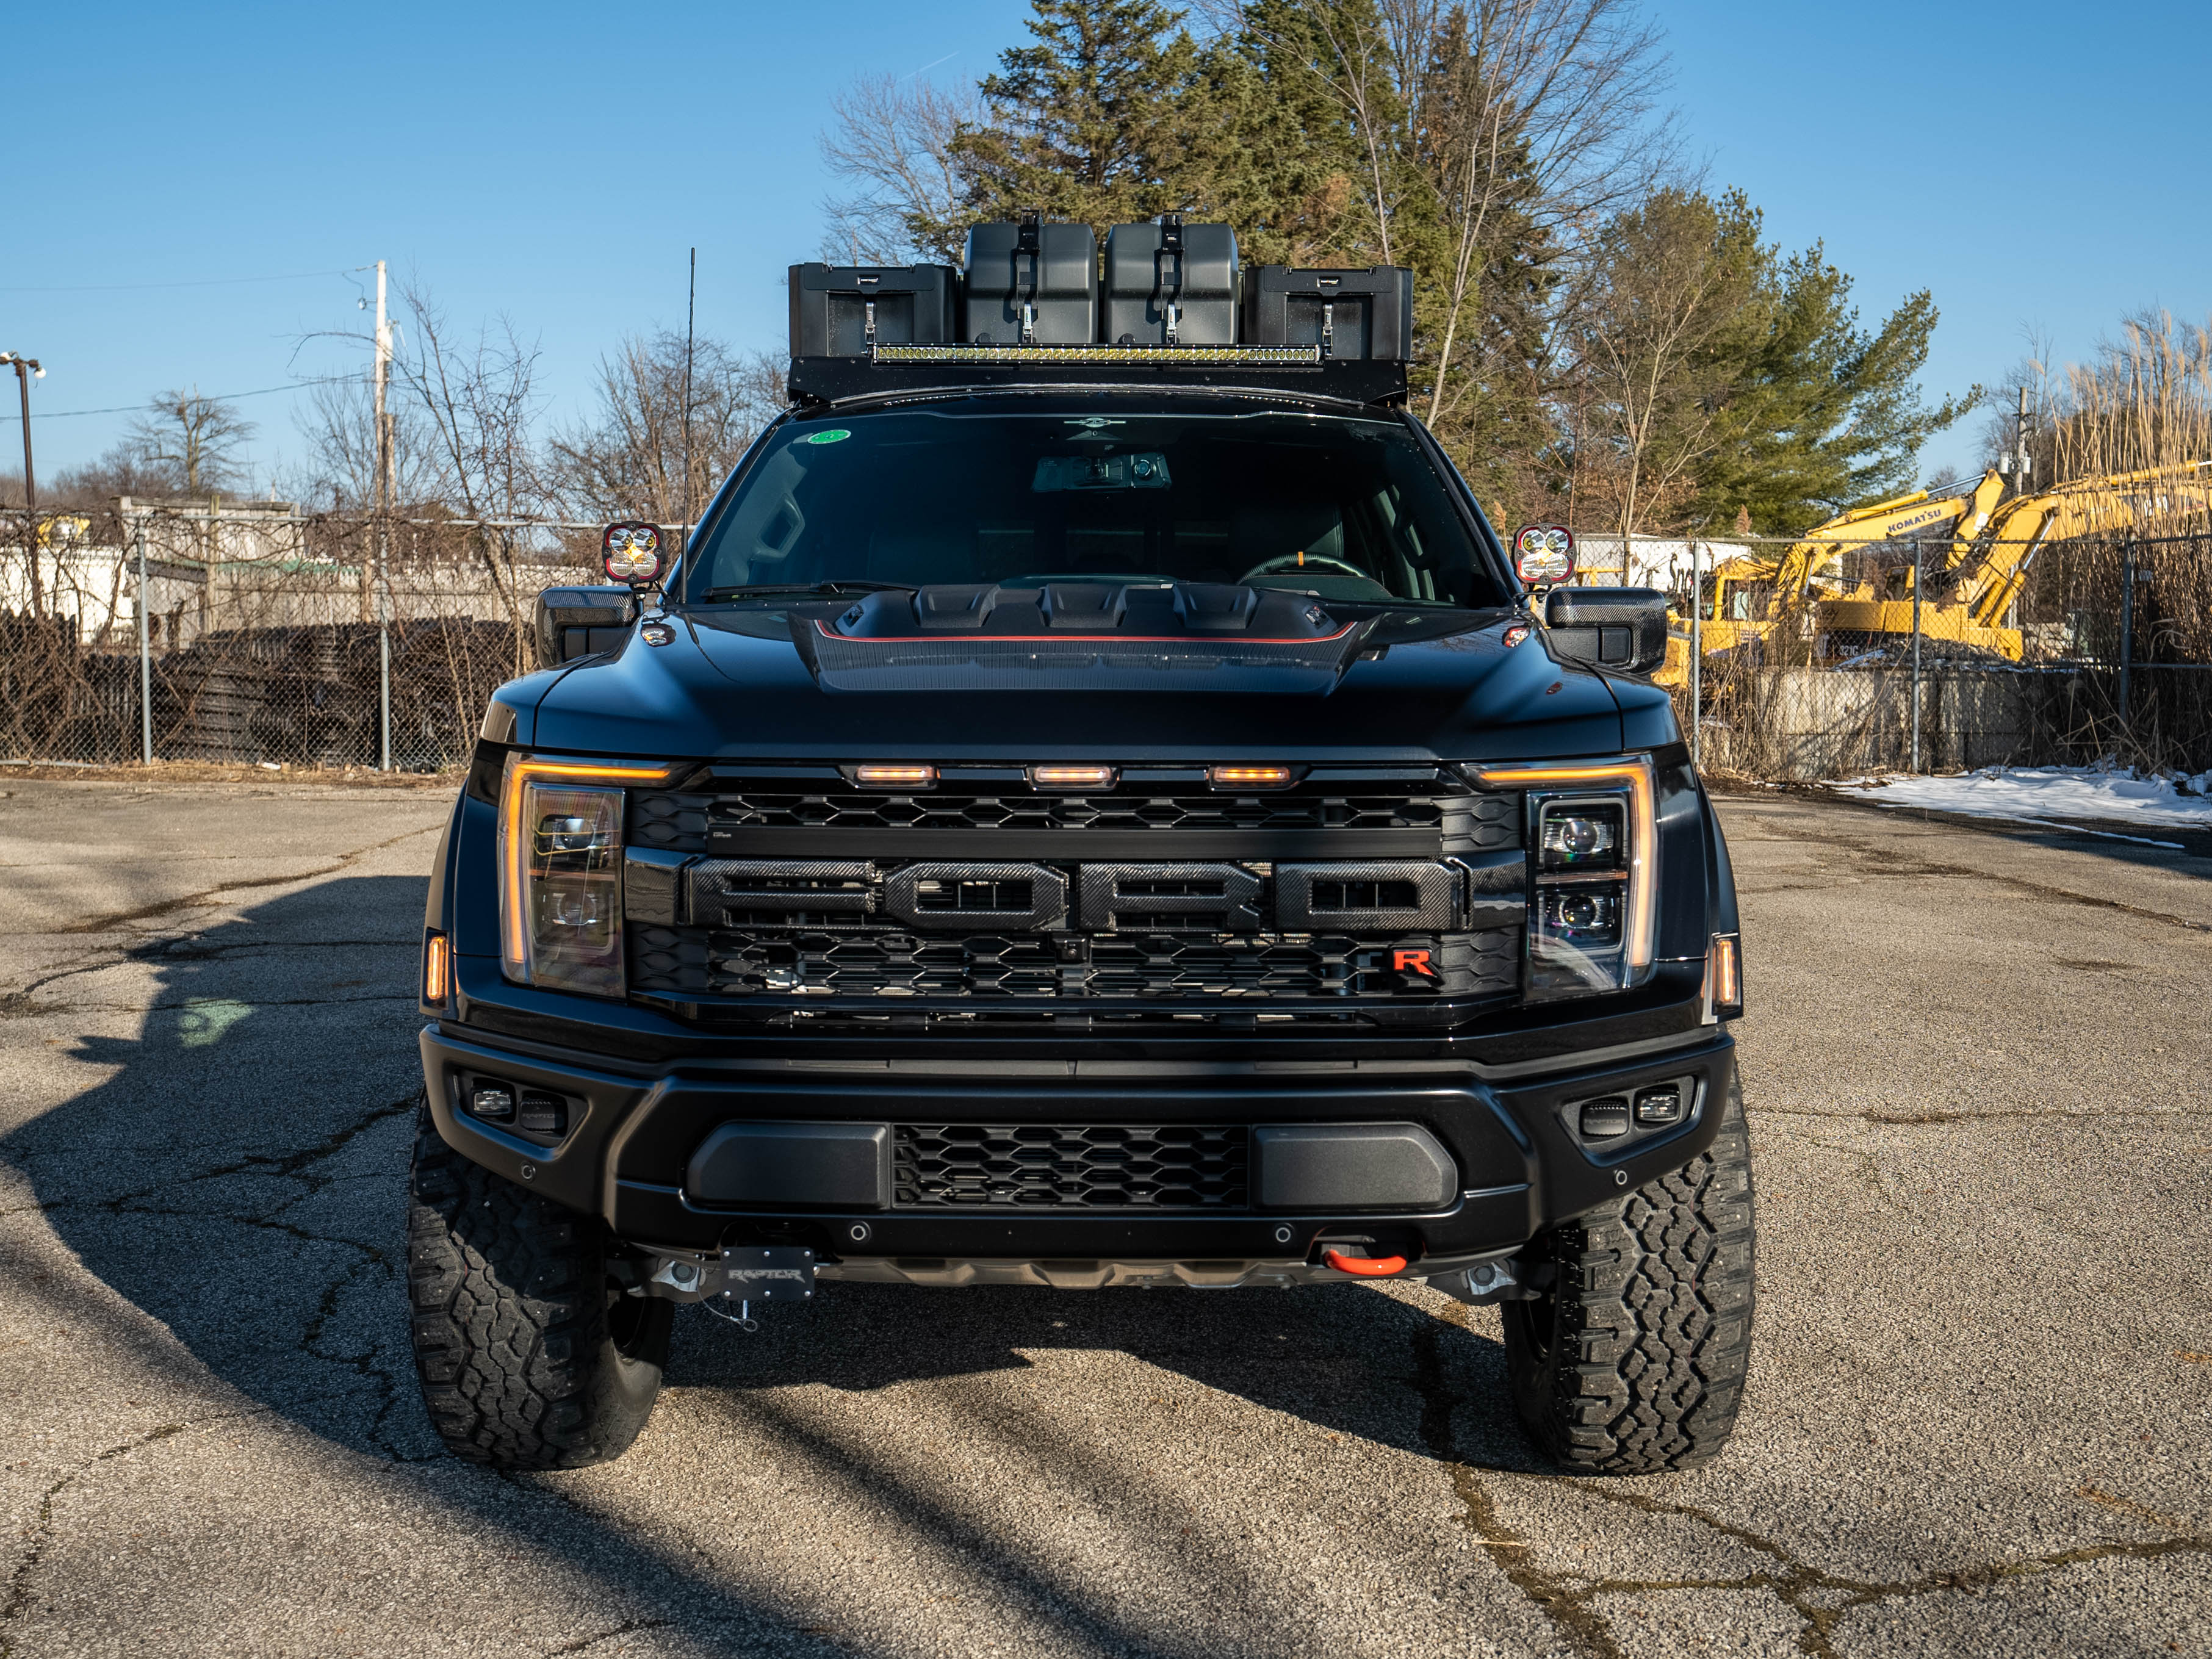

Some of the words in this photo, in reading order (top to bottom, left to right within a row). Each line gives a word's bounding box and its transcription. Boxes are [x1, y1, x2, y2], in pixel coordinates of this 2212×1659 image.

[1887, 509, 1942, 533] KOMATSU
[686, 859, 1458, 933] FORD
[1393, 949, 1438, 978] R
[728, 1269, 805, 1283] RAPTOR
